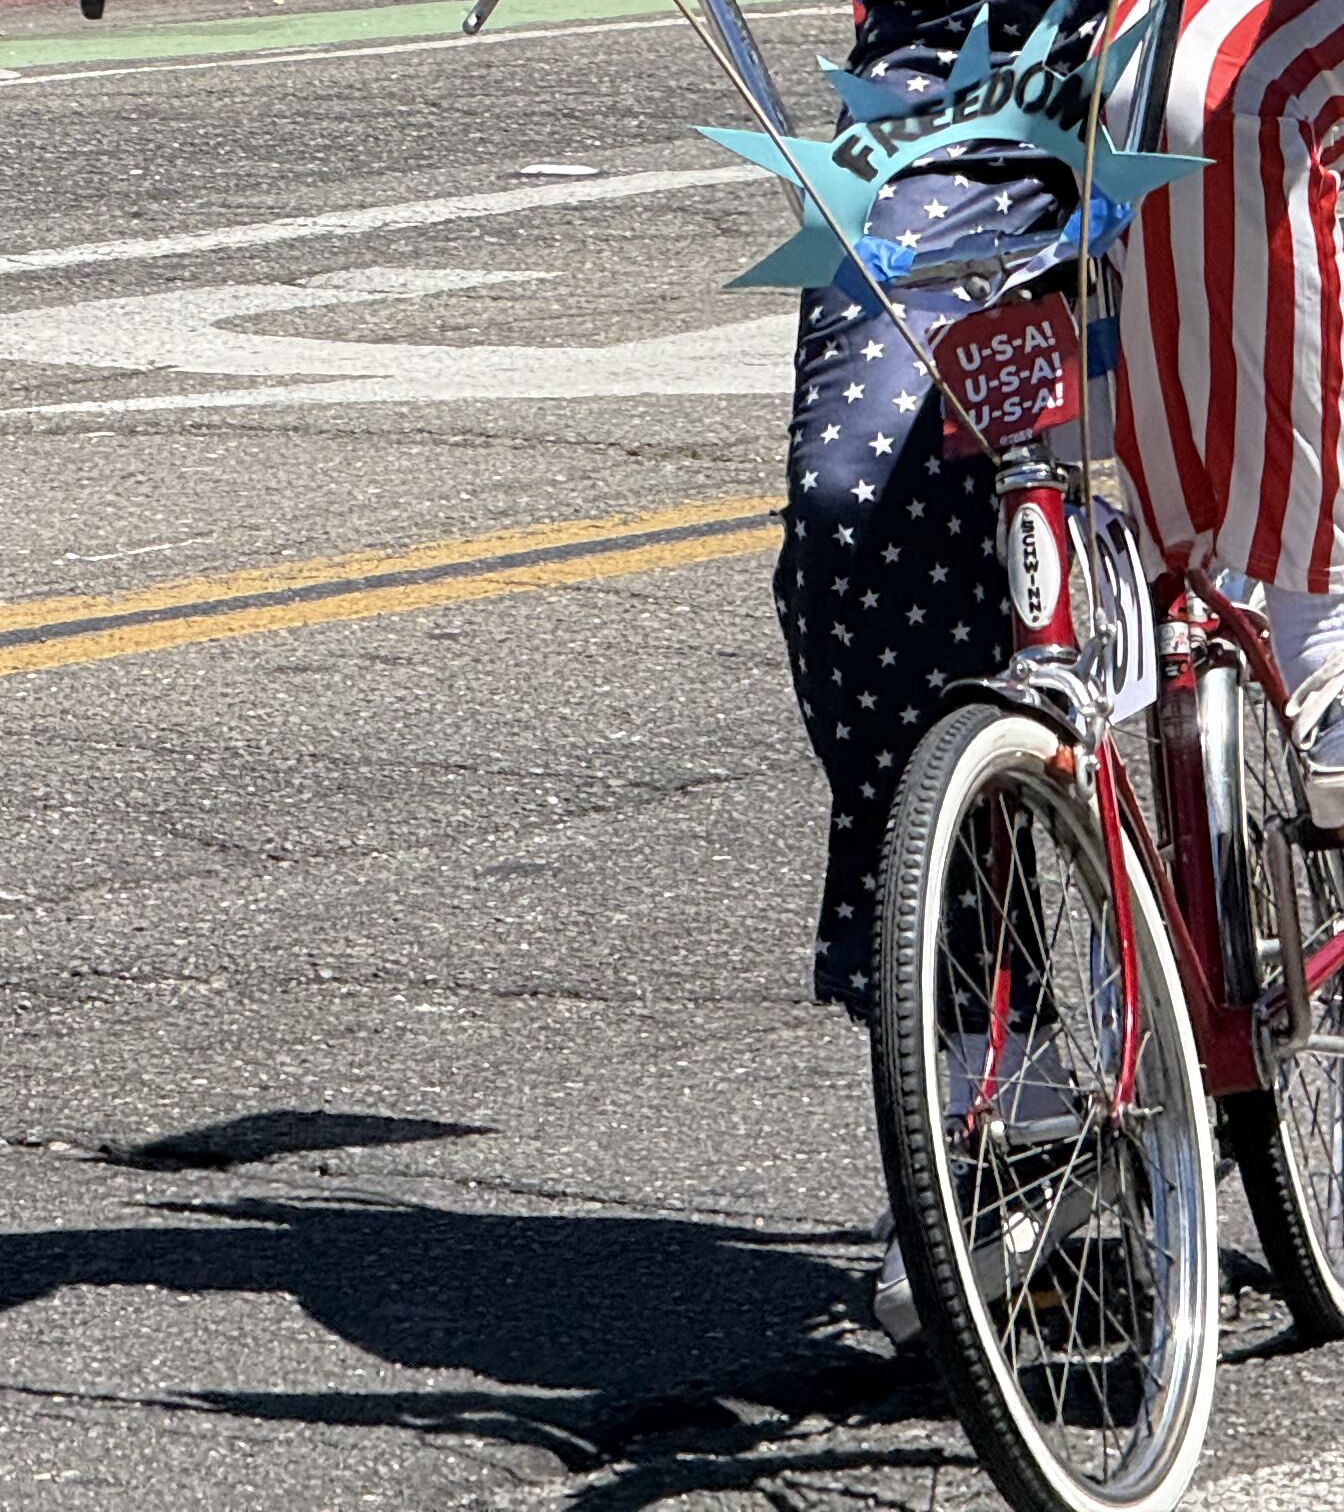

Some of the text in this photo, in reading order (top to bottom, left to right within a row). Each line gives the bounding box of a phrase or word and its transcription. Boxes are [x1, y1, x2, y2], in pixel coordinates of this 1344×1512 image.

[832, 60, 1106, 182] FREEDOM
[956, 320, 1056, 372] U-S-A!
[964, 351, 1064, 404] U-S-A!
[967, 382, 1065, 432] U-S-A!
[1020, 518, 1043, 615] SCHWINN
